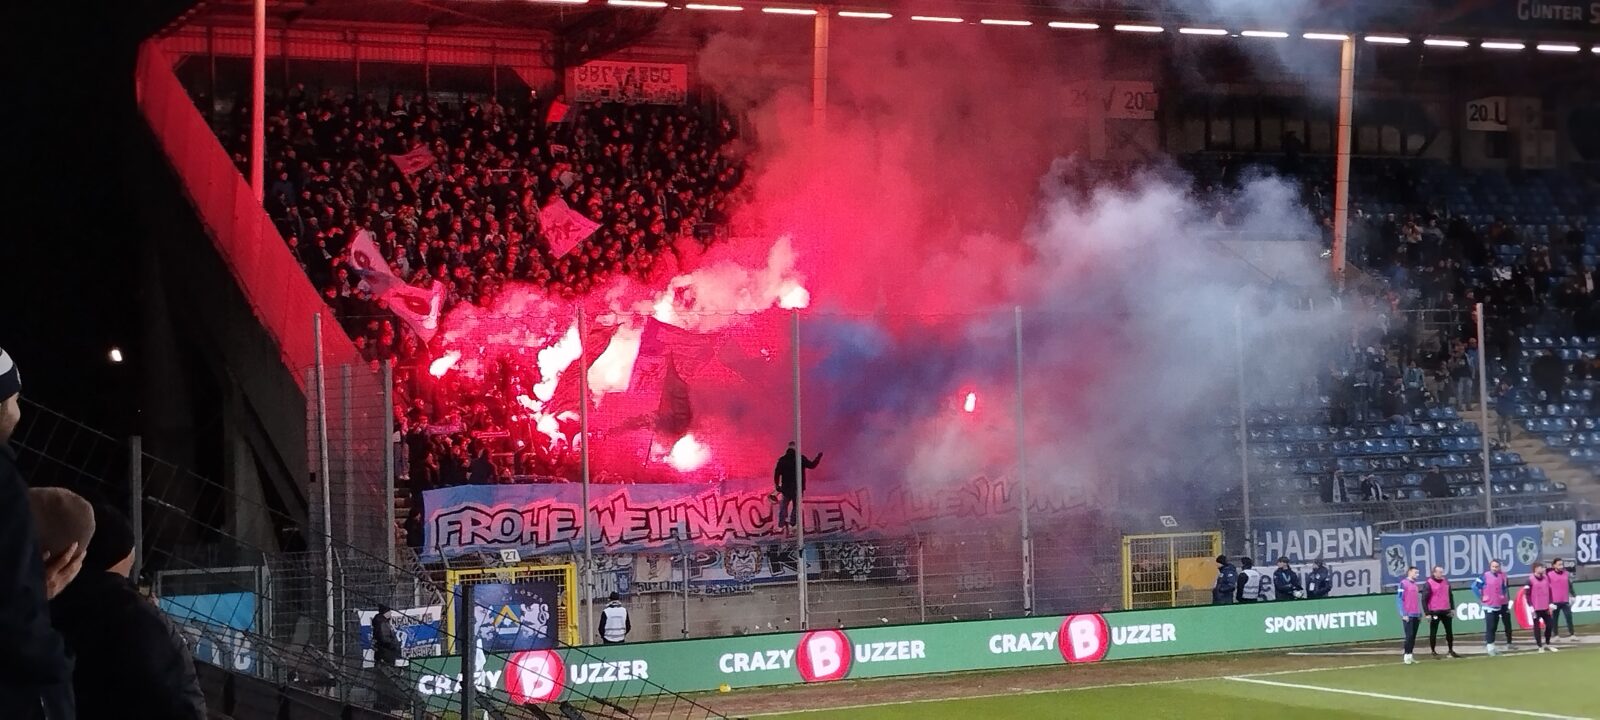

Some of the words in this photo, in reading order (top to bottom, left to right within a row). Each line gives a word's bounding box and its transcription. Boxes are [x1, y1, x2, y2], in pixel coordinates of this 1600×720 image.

[436, 503, 583, 549] FROHE
[503, 551, 518, 561] 27
[1265, 525, 1374, 563] HADERN
[1411, 532, 1514, 578] AUBING
[1264, 610, 1378, 634] SPORTWETTEN
[989, 632, 1058, 654] CRAZY
[718, 649, 795, 674] CRAZY
